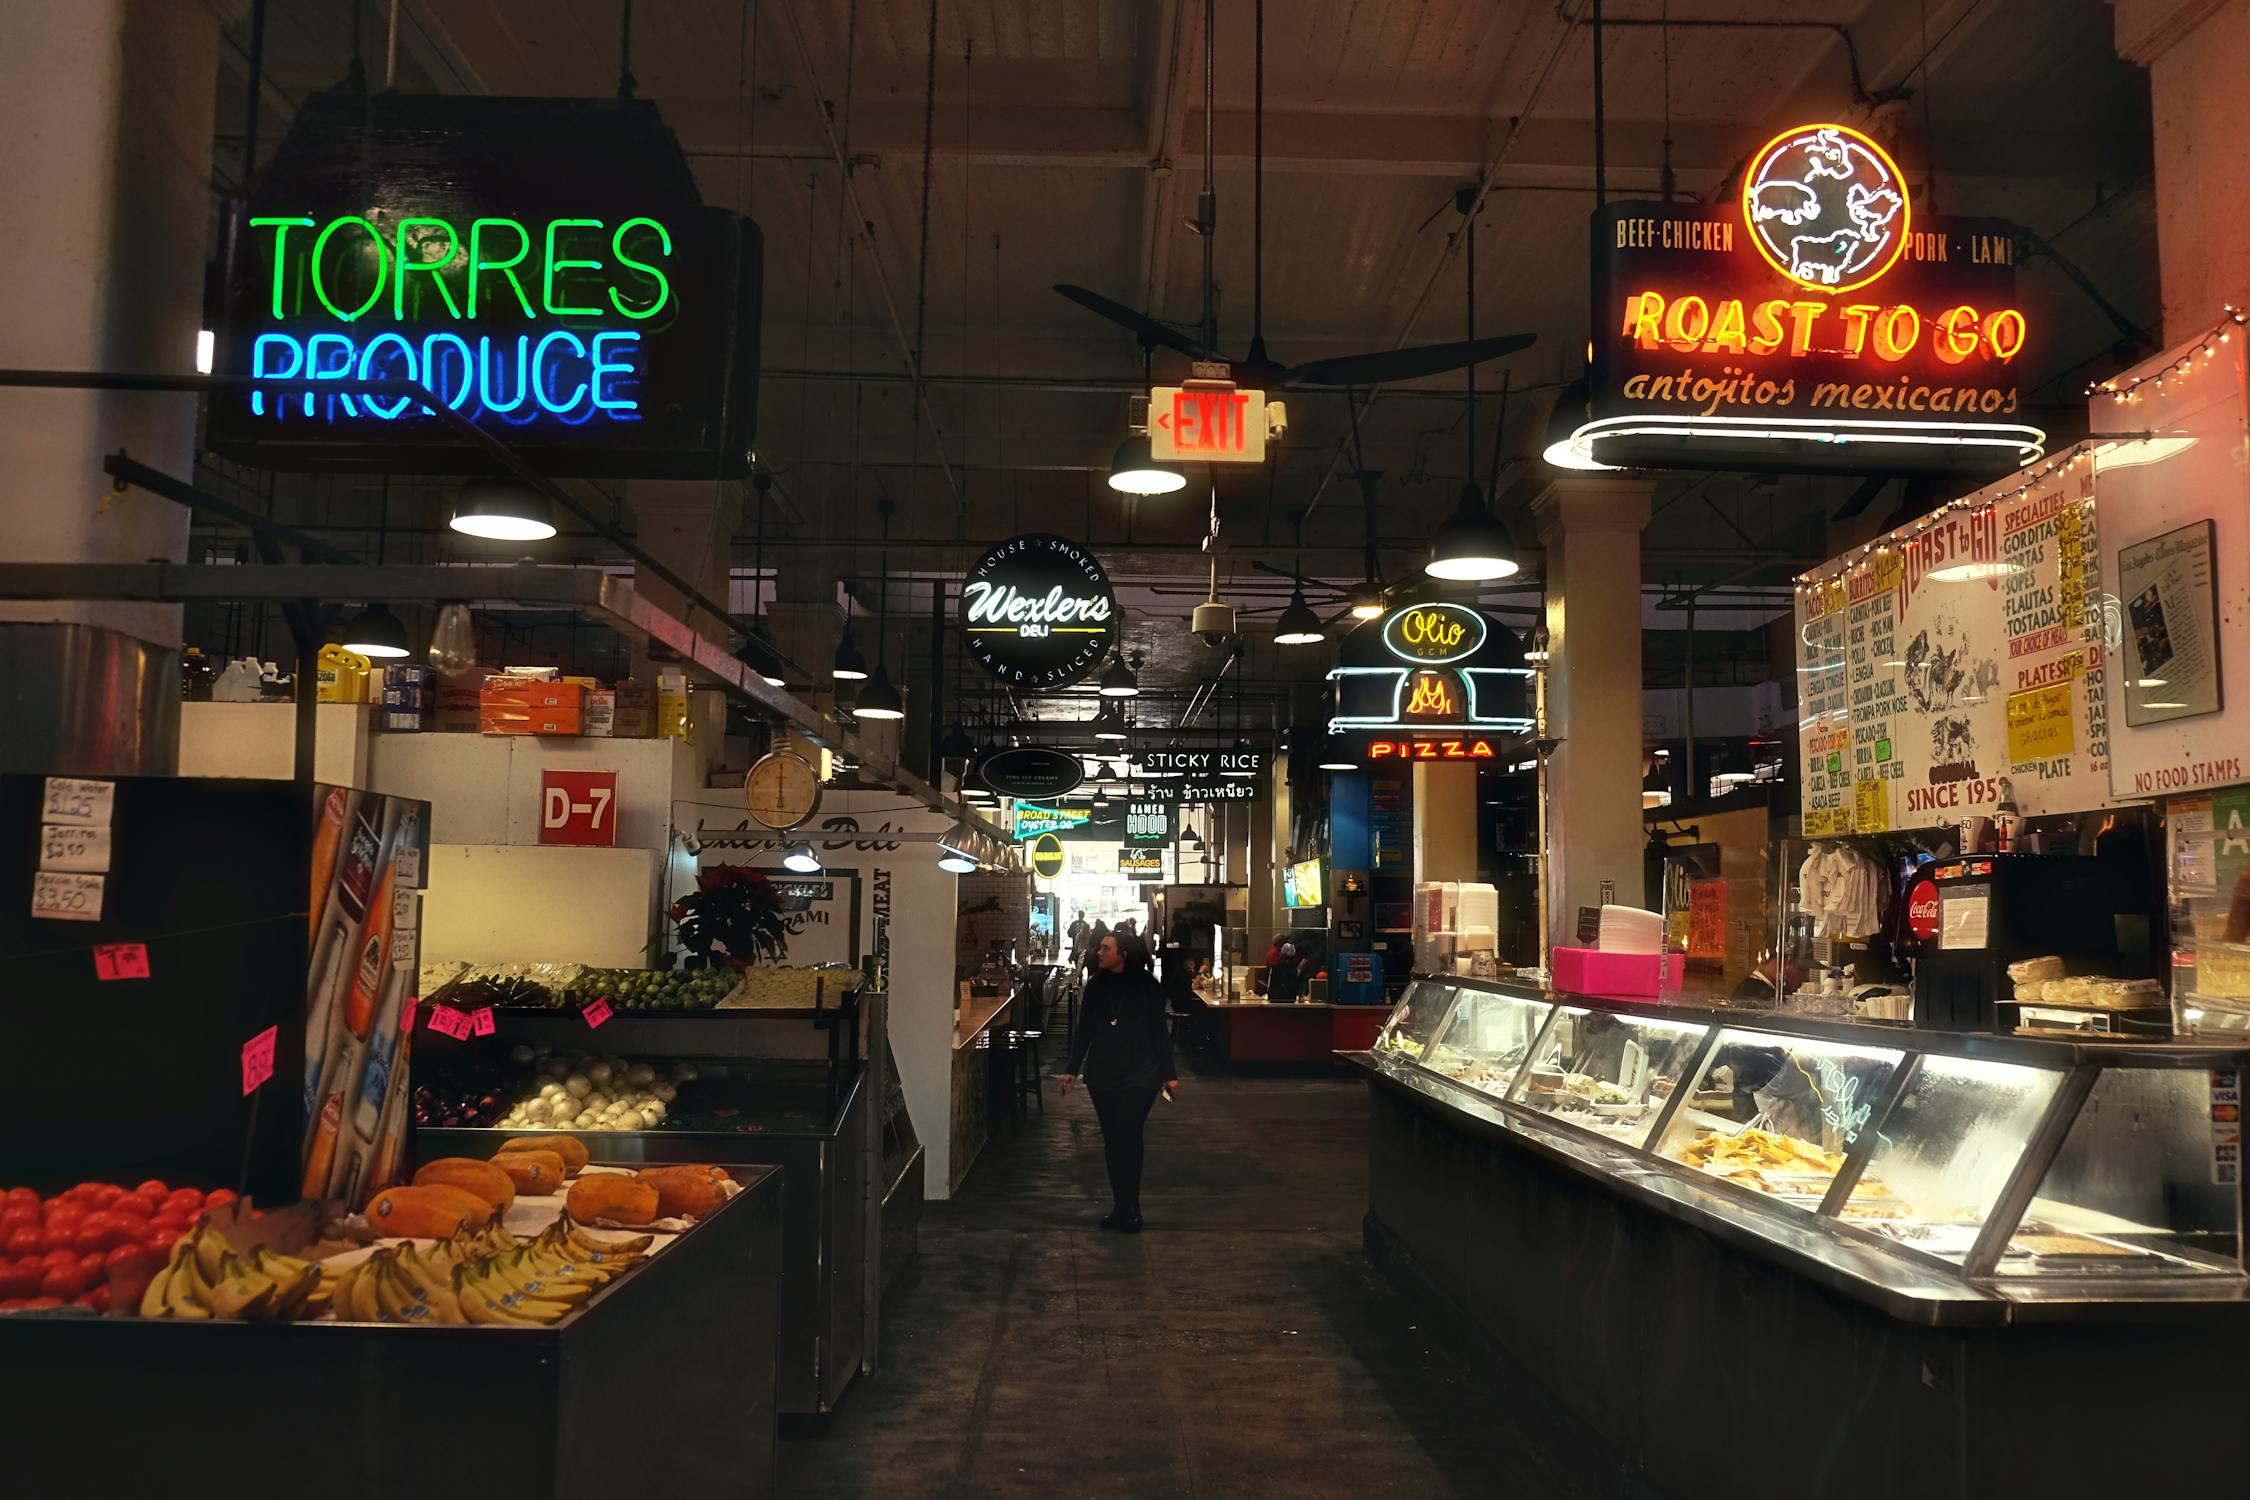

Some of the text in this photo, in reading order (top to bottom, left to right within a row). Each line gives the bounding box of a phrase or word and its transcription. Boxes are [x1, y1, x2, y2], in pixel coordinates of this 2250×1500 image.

[1903, 232, 1948, 263] PORK
[250, 216, 672, 321] TORRES
[1623, 290, 2026, 366] ROAST TO GO
[251, 330, 643, 419] PRODUCE
[1623, 366, 2018, 417] antojitos mexicanos
[1173, 392, 1249, 454] EXIT
[2005, 489, 2065, 531] SPECIALTIES
[2003, 515, 2062, 555] GORDITAS
[978, 539, 1100, 583] HOUSE SMOKED
[1898, 520, 1957, 628] ROAST
[1959, 525, 1970, 554] to
[2005, 567, 2036, 596] SOPES
[963, 581, 1112, 624] Wexler's
[2006, 585, 2054, 617] FLAUTAS
[1020, 623, 1049, 638] DELI
[1401, 610, 1466, 646] Olio
[2007, 604, 2065, 638] TOSTADAS
[971, 638, 1100, 682] HAND SLICED
[1852, 663, 1874, 684] LENGUA
[2018, 659, 2066, 689] PLATES
[1875, 701, 1892, 719] PORK
[1892, 695, 1908, 716] NOSE
[1147, 753, 1260, 769] STICKY RICE
[1370, 741, 1494, 759] PIZZA
[2010, 758, 2072, 780] CHICKEN PLATE
[2134, 757, 2242, 793] NO FOOD STAMPS
[49, 778, 72, 792] Cold
[1907, 784, 1959, 812] SINCE
[545, 787, 612, 829] D-7
[1017, 809, 1092, 820] BROAD STREET
[1130, 803, 1165, 815] RAMEN
[1021, 820, 1058, 832] OYSTER
[1127, 814, 1168, 835] HOOD
[2222, 809, 2250, 856] A
[1119, 859, 1161, 867] SAUSAGES
[2213, 1090, 2239, 1102] VISA
